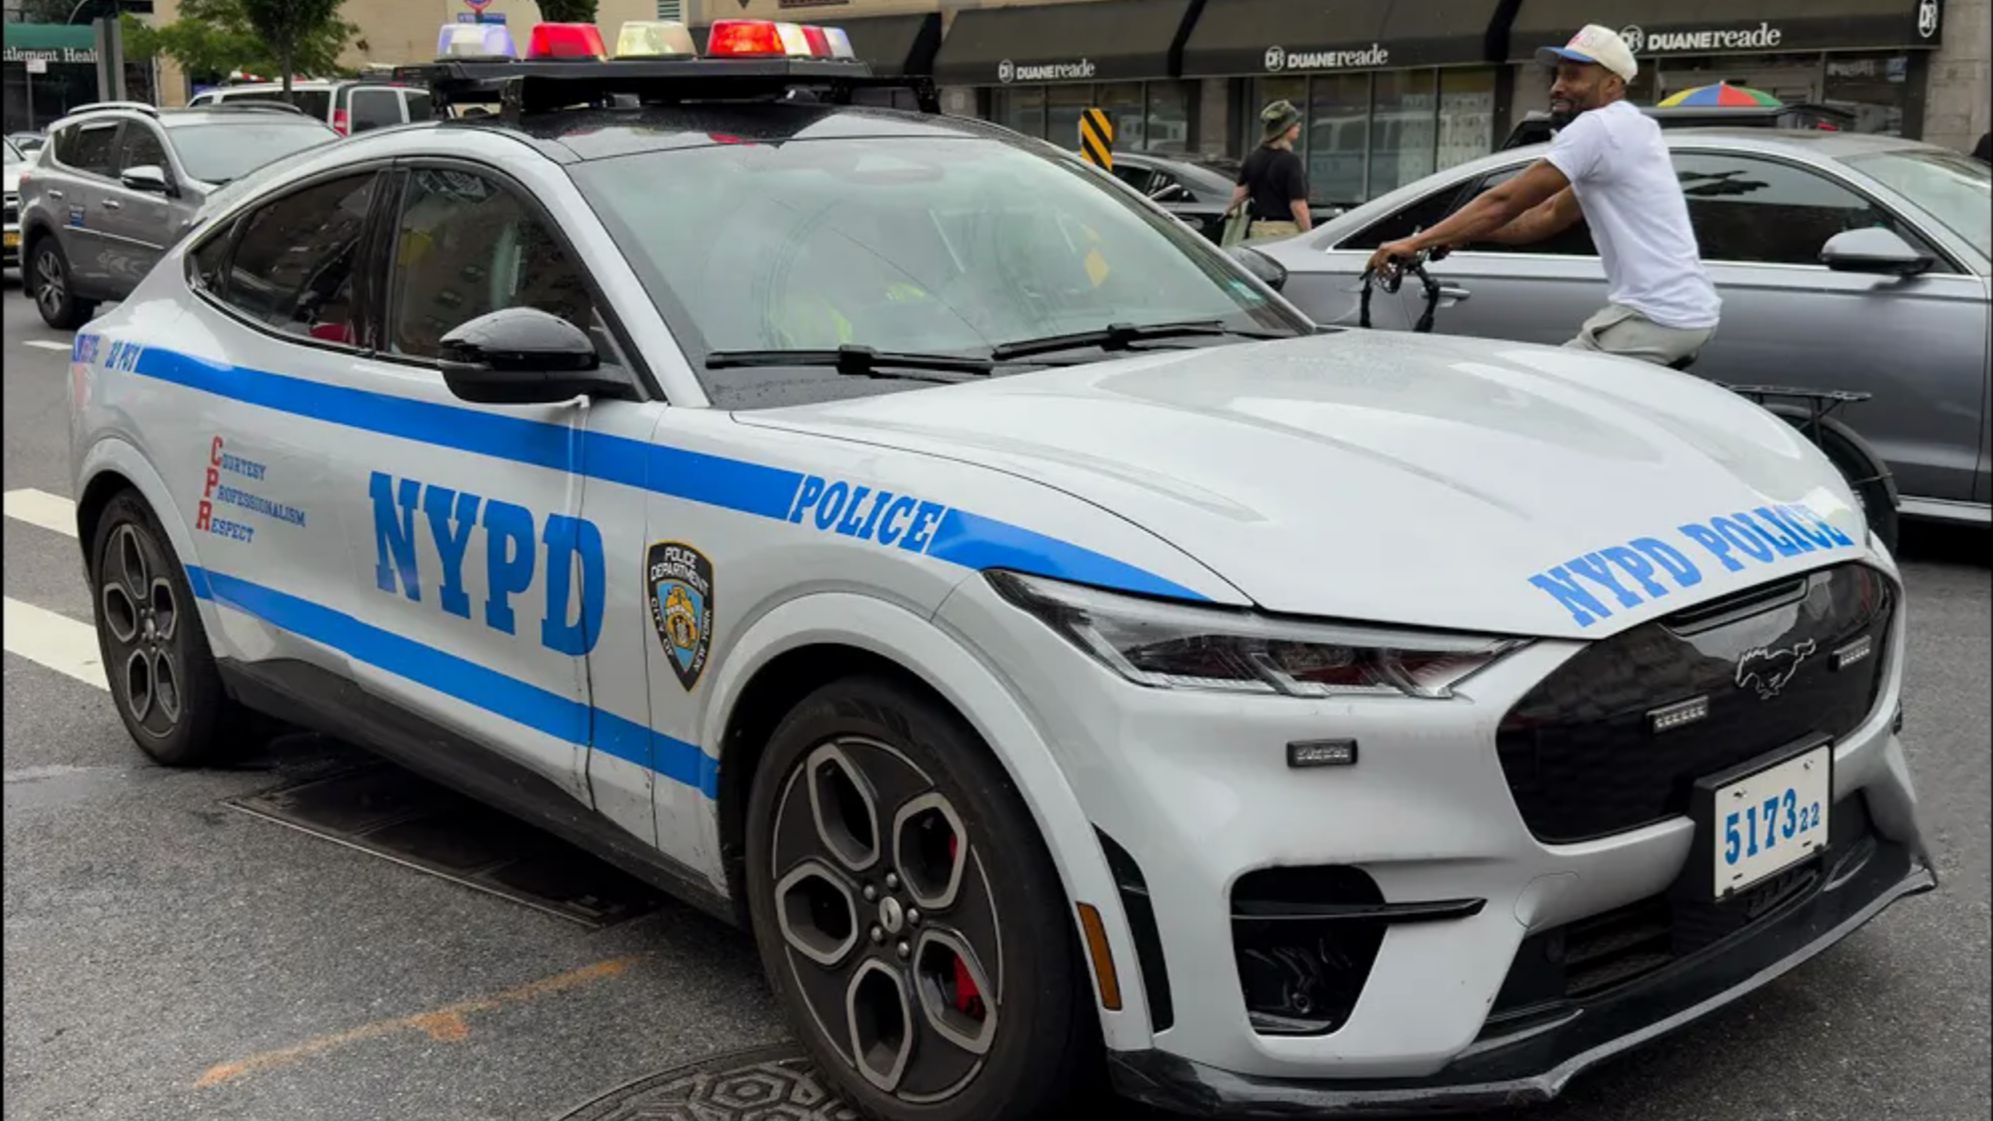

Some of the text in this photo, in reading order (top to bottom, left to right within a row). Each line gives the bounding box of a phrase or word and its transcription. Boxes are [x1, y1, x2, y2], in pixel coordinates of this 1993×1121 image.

[789, 474, 945, 553] POLICE
[369, 471, 606, 656] NYPD
[651, 562, 709, 597] DEPARTMENT
[664, 546, 697, 570] POLICE
[1527, 504, 1855, 628] NYPD POLICE
[1725, 788, 1796, 865] 5173
